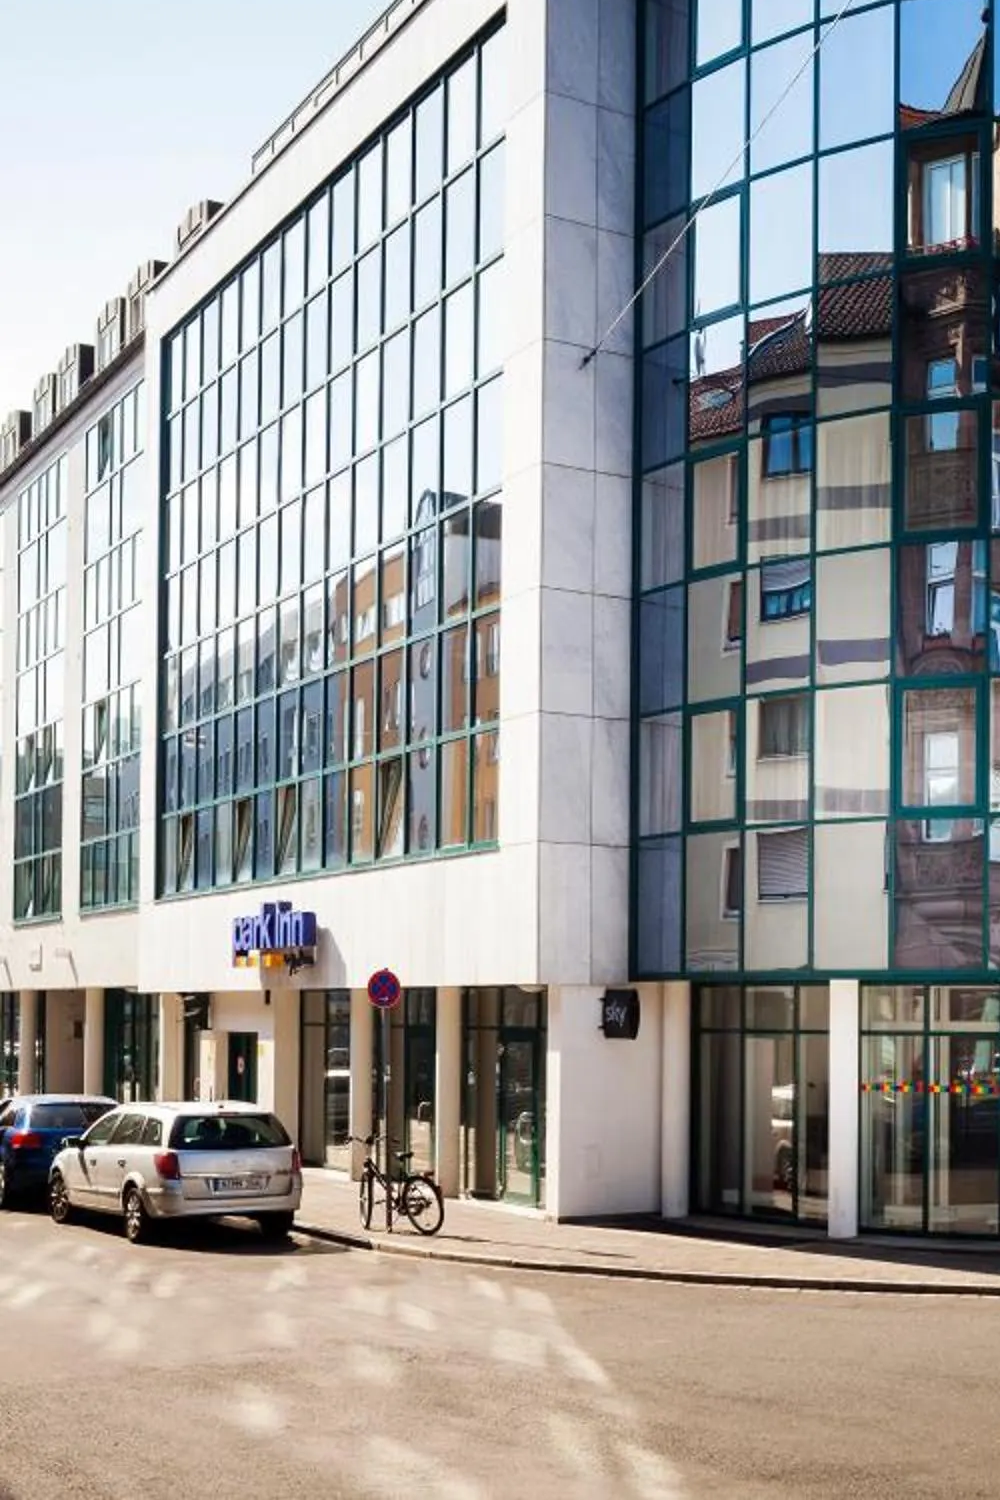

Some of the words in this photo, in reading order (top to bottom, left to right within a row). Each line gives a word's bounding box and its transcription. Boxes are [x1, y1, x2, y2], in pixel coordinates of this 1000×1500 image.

[232, 902, 273, 968] park
[275, 901, 304, 949] inn
[606, 1000, 627, 1028] sky
